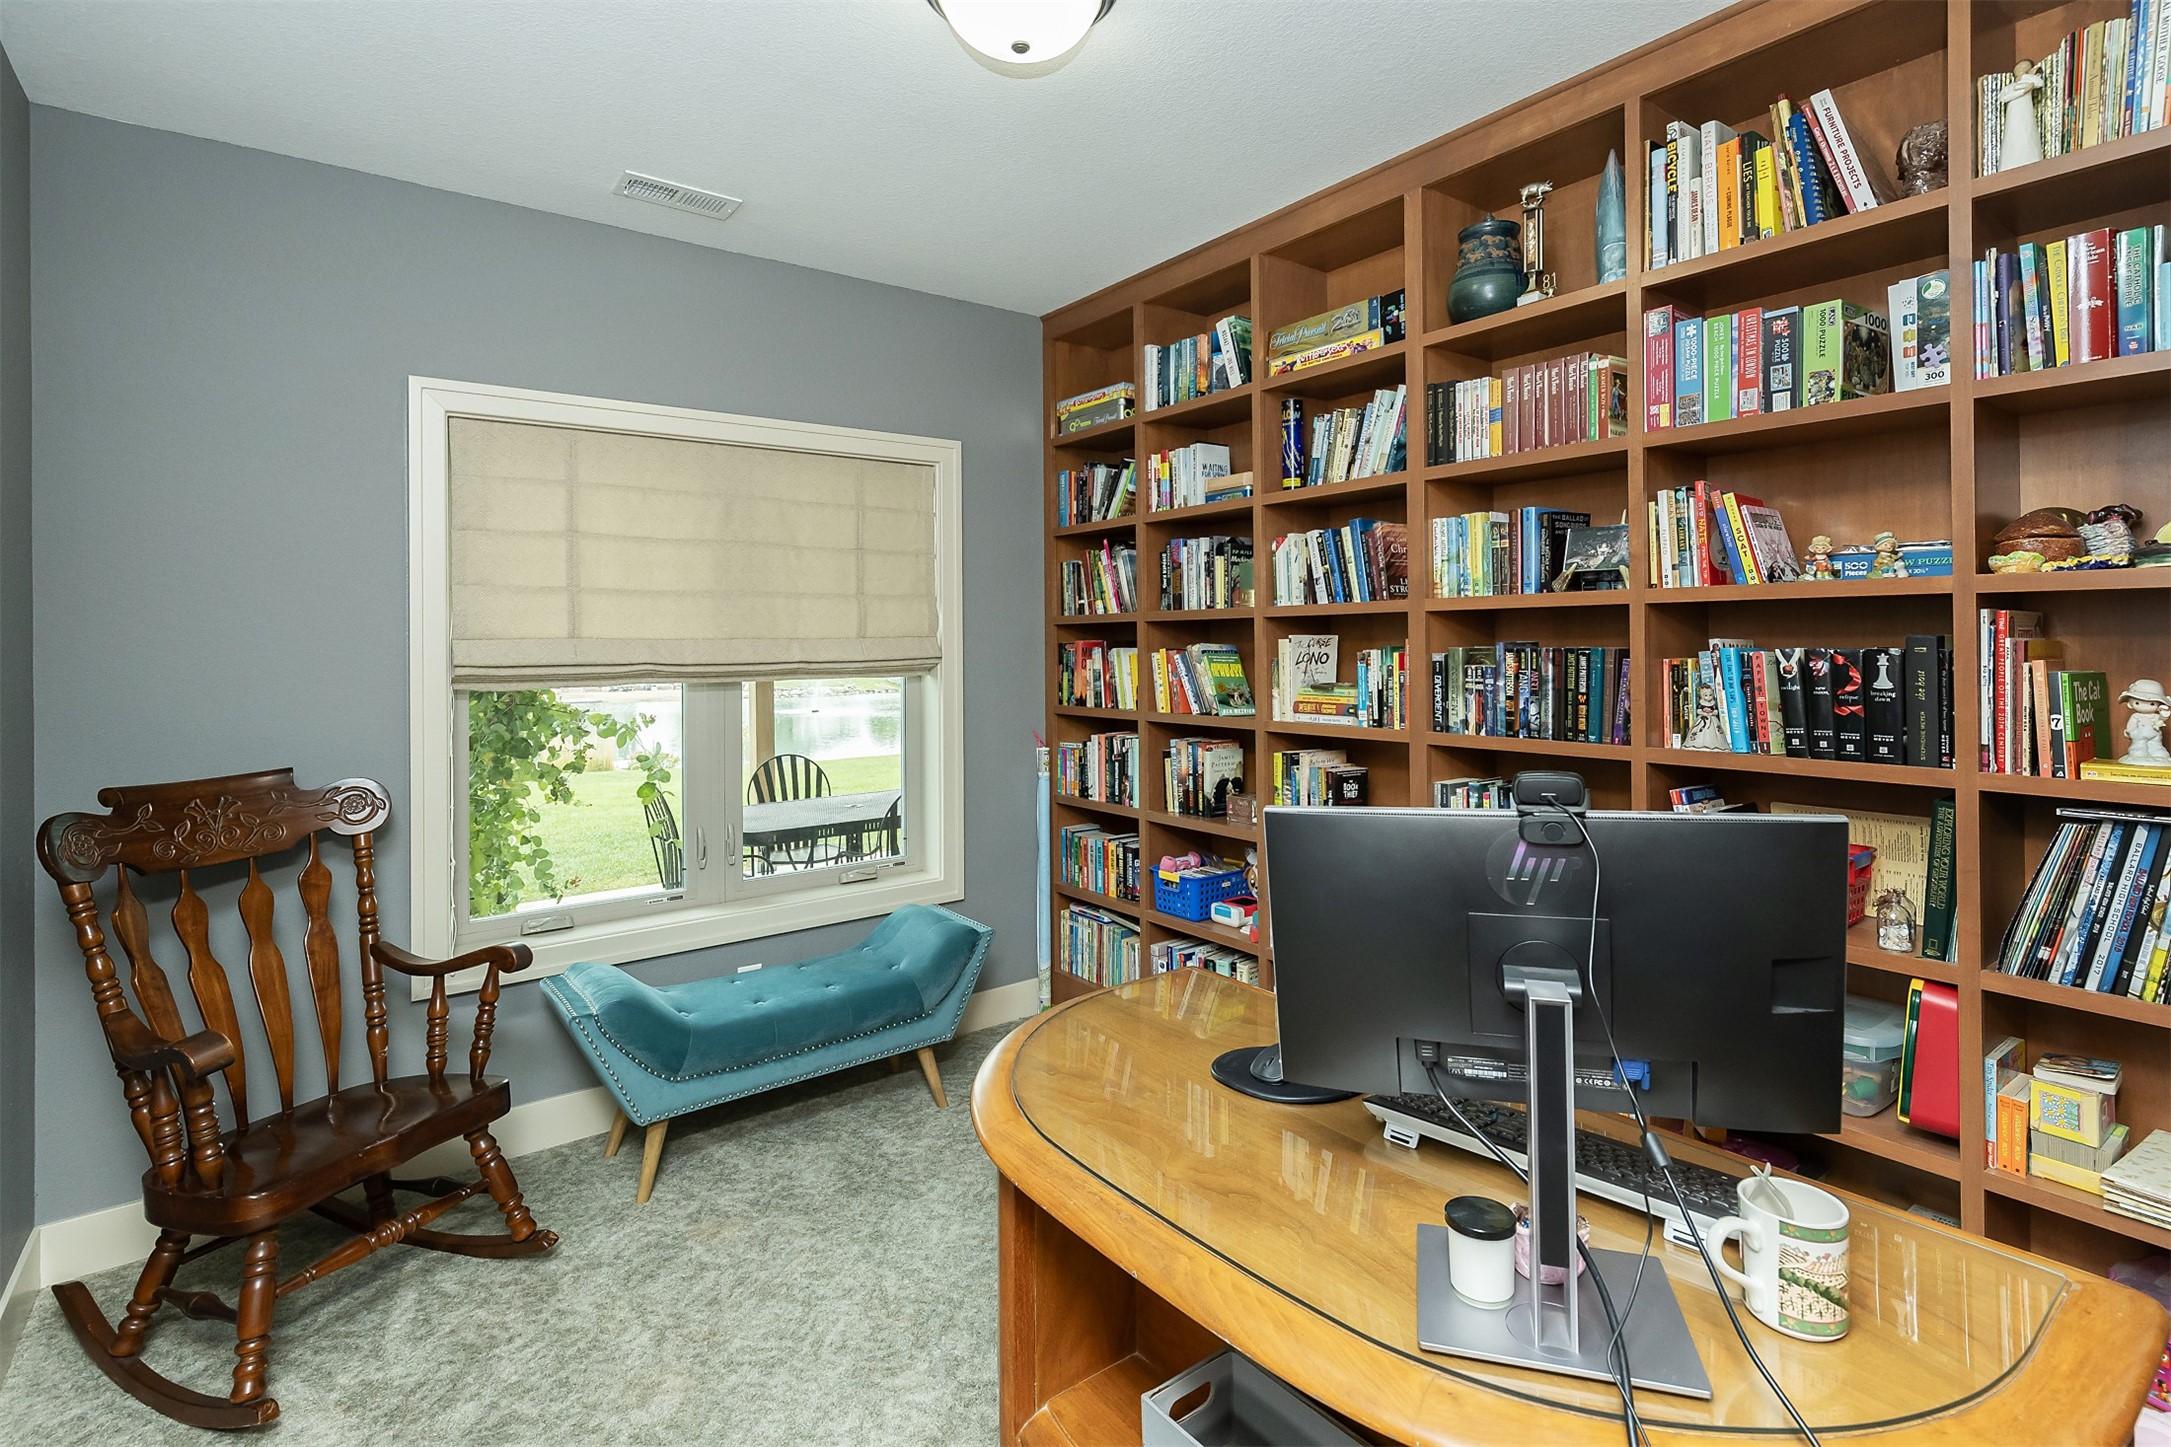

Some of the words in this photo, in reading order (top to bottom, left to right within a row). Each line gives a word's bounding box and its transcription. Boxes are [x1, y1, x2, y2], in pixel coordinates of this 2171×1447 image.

[2159, 15, 2170, 51] MOTHER
[2155, 55, 2167, 85] GOOSE
[1704, 130, 1714, 164] NATE
[1822, 106, 1845, 148] FURNITURE
[1841, 149, 1862, 189] PROJECTS
[1667, 146, 1680, 195] BICYCLE
[1743, 161, 1753, 183] LIES
[1704, 165, 1714, 206] BERKUS
[2134, 245, 2142, 260] THE
[2124, 281, 2133, 308] BIBLE
[2133, 262, 2142, 304] CATHOLIC
[1745, 314, 1757, 347] CHRISTMAS
[1863, 313, 1887, 331] 1000
[1781, 338, 1790, 353] 500
[1690, 337, 1698, 380] 1000-PIECE
[1745, 355, 1757, 379] LONDON
[1924, 371, 1945, 382] 300
[1202, 463, 1228, 472] WAITING
[1697, 519, 1707, 544] NATE
[1736, 527, 1748, 557] SCAT
[1390, 543, 1408, 554] Chr
[1844, 561, 1868, 570] 500
[1295, 651, 1330, 665] LONO
[1506, 668, 1515, 696] PATTERSON
[1915, 670, 1926, 686] host
[1434, 675, 1442, 723] DIVERGENT
[1870, 690, 1897, 698] breaking
[1915, 689, 1926, 701] the
[1999, 686, 2004, 694] OF
[2073, 681, 2088, 702] The
[2088, 681, 2101, 700] Cat
[1759, 703, 1767, 739] TOWNS
[2052, 718, 2061, 728] 7
[2076, 702, 2095, 724] Book
[1343, 783, 1359, 791] BOOK
[1343, 790, 1359, 799] THIEF
[1934, 821, 1944, 857] ADVENTURE
[1942, 807, 1954, 855] EXPLORING
[1939, 856, 1950, 879] YOUR
[2123, 842, 2143, 882] BALLARD
[2133, 868, 2148, 895] BALLARD
[1936, 879, 1948, 910] WORLD
[2116, 883, 2129, 905] HIGH
[2104, 907, 2122, 943] SCHOOL
[2119, 911, 2136, 932] SCHOOL
[2093, 954, 2105, 975] 2017
